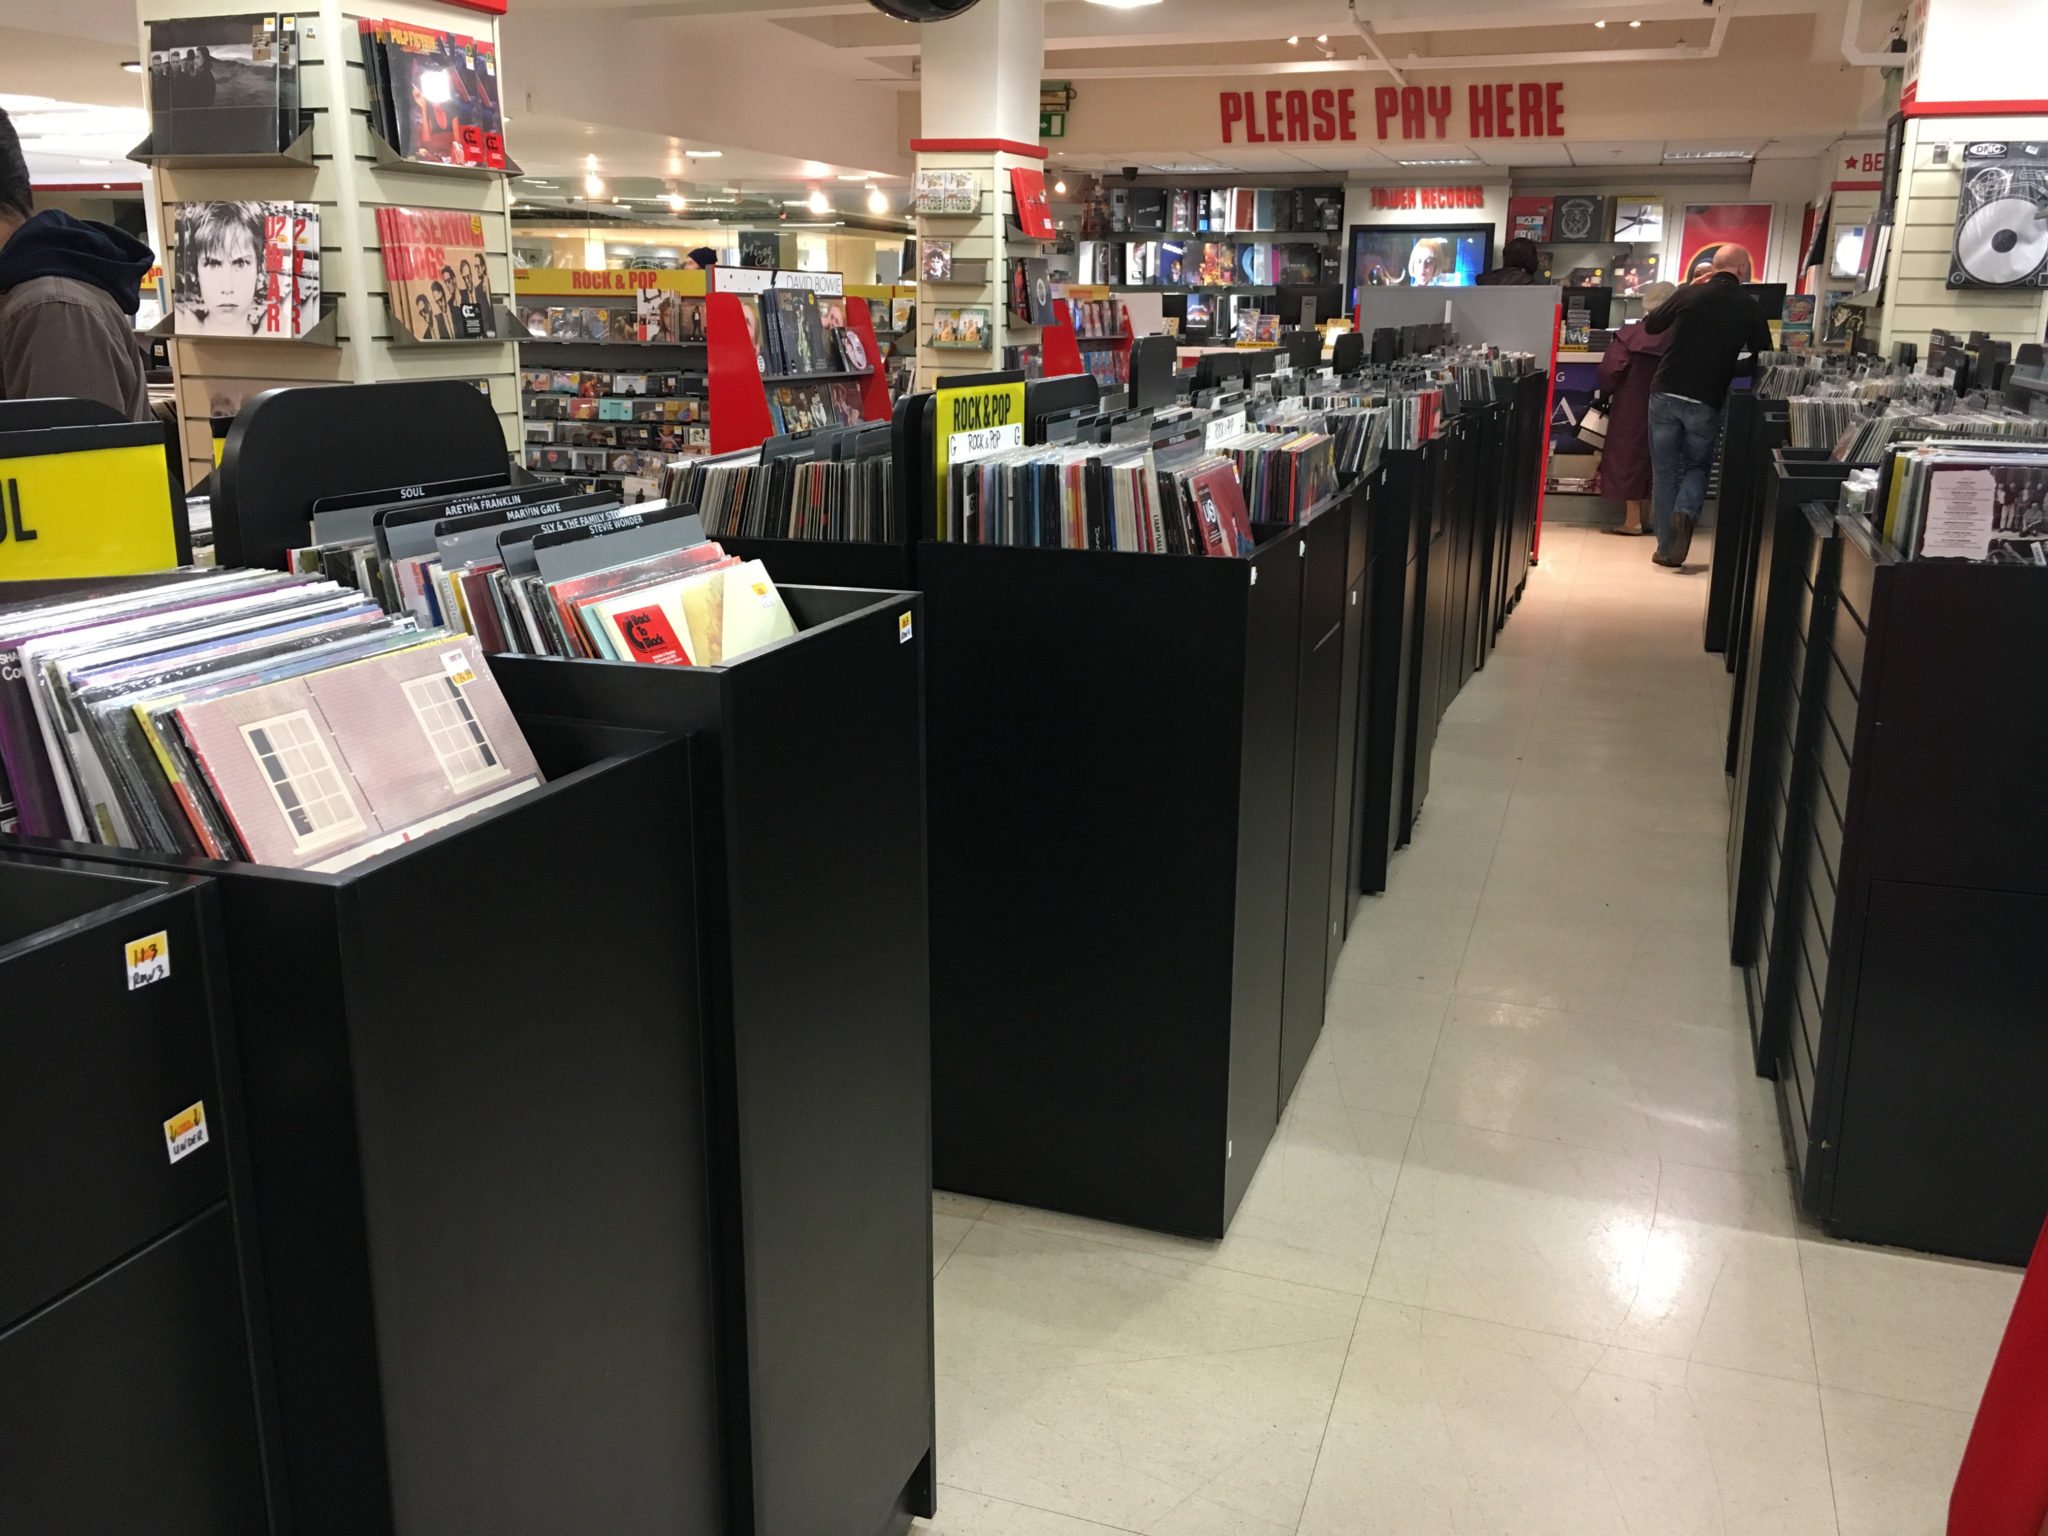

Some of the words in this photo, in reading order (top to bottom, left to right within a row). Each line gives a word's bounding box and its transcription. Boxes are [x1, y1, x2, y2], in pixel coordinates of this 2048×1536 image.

[1219, 88, 1357, 143] PLEASE
[1375, 85, 1451, 140] PAY
[1468, 82, 1565, 138] HERE
[1862, 152, 1885, 172] BE
[1370, 186, 1417, 210] TOWER
[1421, 185, 1484, 209] RECORDS
[265, 215, 286, 239] U2
[572, 271, 612, 289] ROCK
[615, 274, 626, 289] &
[628, 271, 657, 289] POP
[786, 275, 812, 289] DAVID
[814, 276, 841, 293] BOWIE
[953, 395, 982, 432] ROCK
[983, 394, 990, 428] &
[992, 393, 1011, 426] POP
[400, 486, 425, 499] SOUL
[445, 502, 480, 516] ARETHA
[480, 494, 522, 510] FRANKLIN
[506, 505, 539, 521] MARVIN
[540, 502, 561, 516] GAYE
[540, 523, 555, 534] SLY
[563, 519, 580, 529] THE
[580, 512, 605, 527] FAMILY
[589, 523, 614, 535] STEVIE
[614, 515, 644, 529] WONDER
[631, 612, 651, 626] Back
[642, 634, 665, 649] Black
[173, 1129, 203, 1156] UNDER
